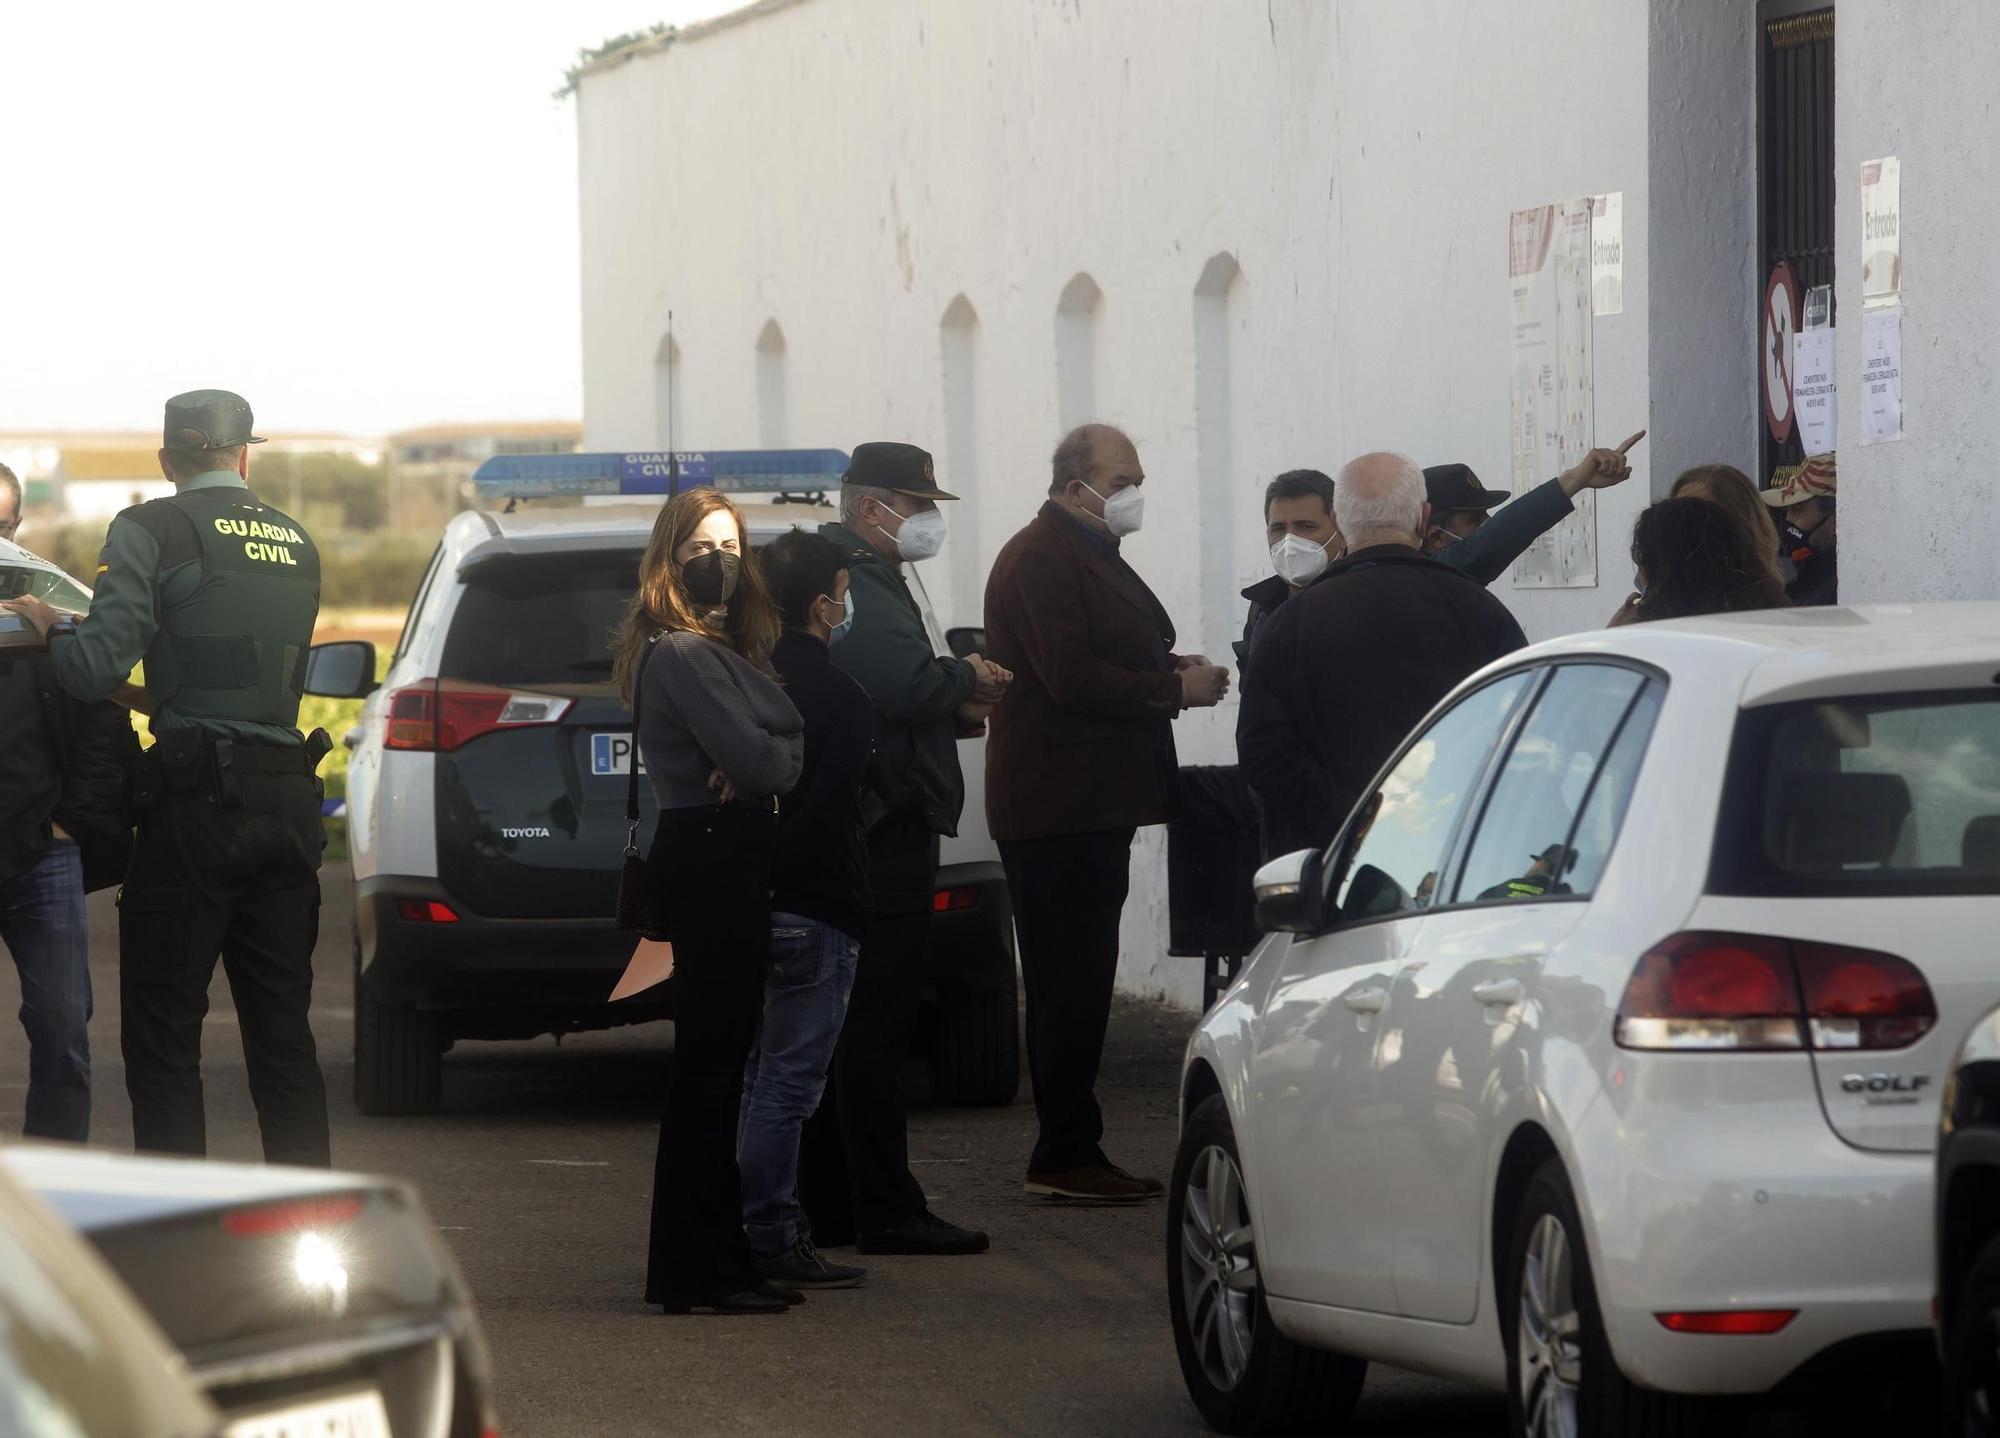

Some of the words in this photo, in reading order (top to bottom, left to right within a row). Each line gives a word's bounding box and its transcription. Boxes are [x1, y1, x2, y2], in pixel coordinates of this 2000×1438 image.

[1866, 206, 1897, 240] Entrada
[1593, 236, 1620, 265] Entrada
[642, 464, 689, 476] CIVL
[214, 518, 304, 544] GUARDIA
[245, 541, 297, 565] CIVIL
[598, 757, 607, 767] E
[501, 827, 550, 838] TOYOTA
[1840, 1073, 1931, 1093] GOLF
